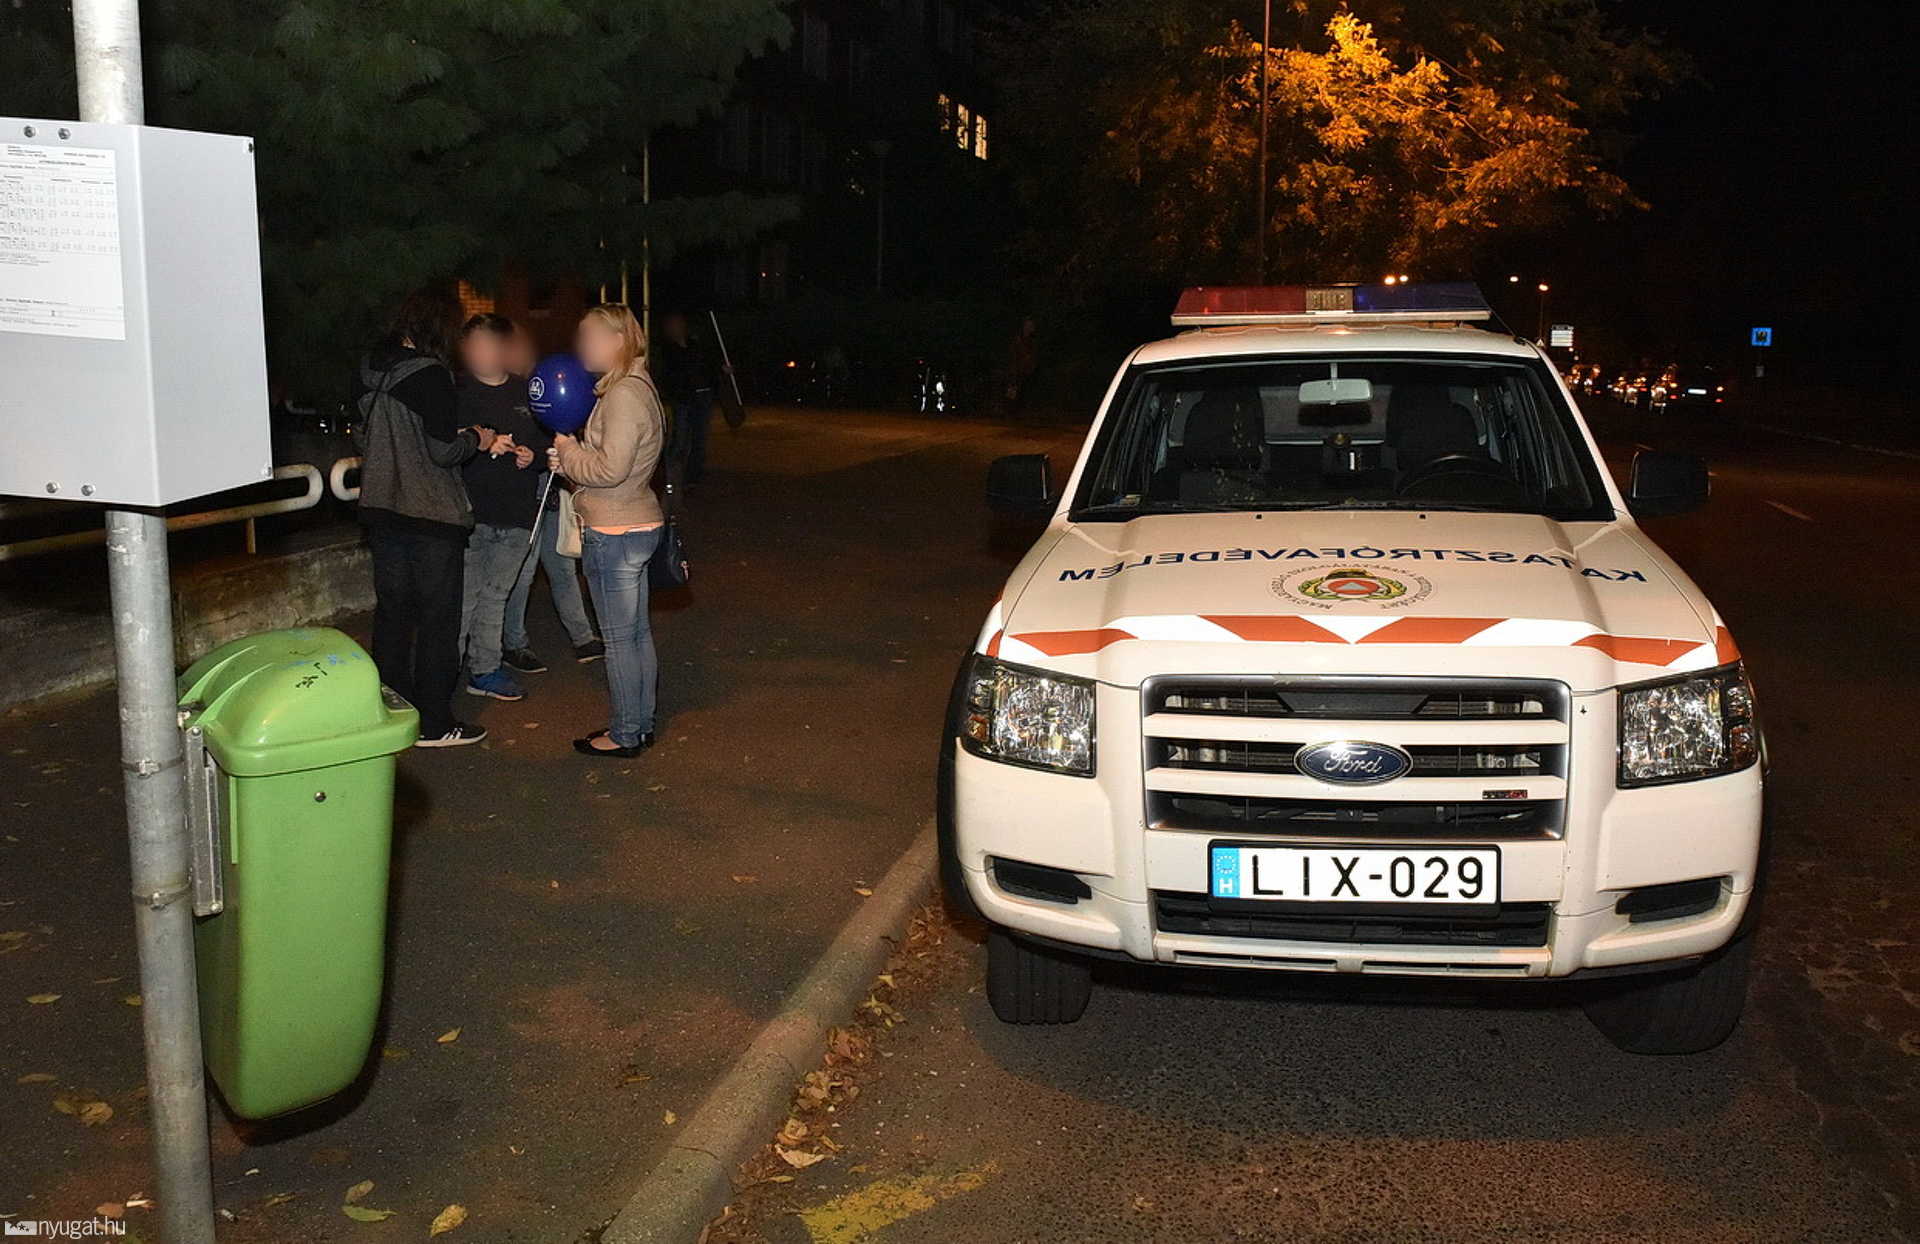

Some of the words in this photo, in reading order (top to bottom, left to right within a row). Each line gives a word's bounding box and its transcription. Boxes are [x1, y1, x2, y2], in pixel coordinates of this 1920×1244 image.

[1323, 747, 1383, 774] Ford
[1218, 877, 1234, 894] H
[1252, 854, 1484, 899] LIX-029
